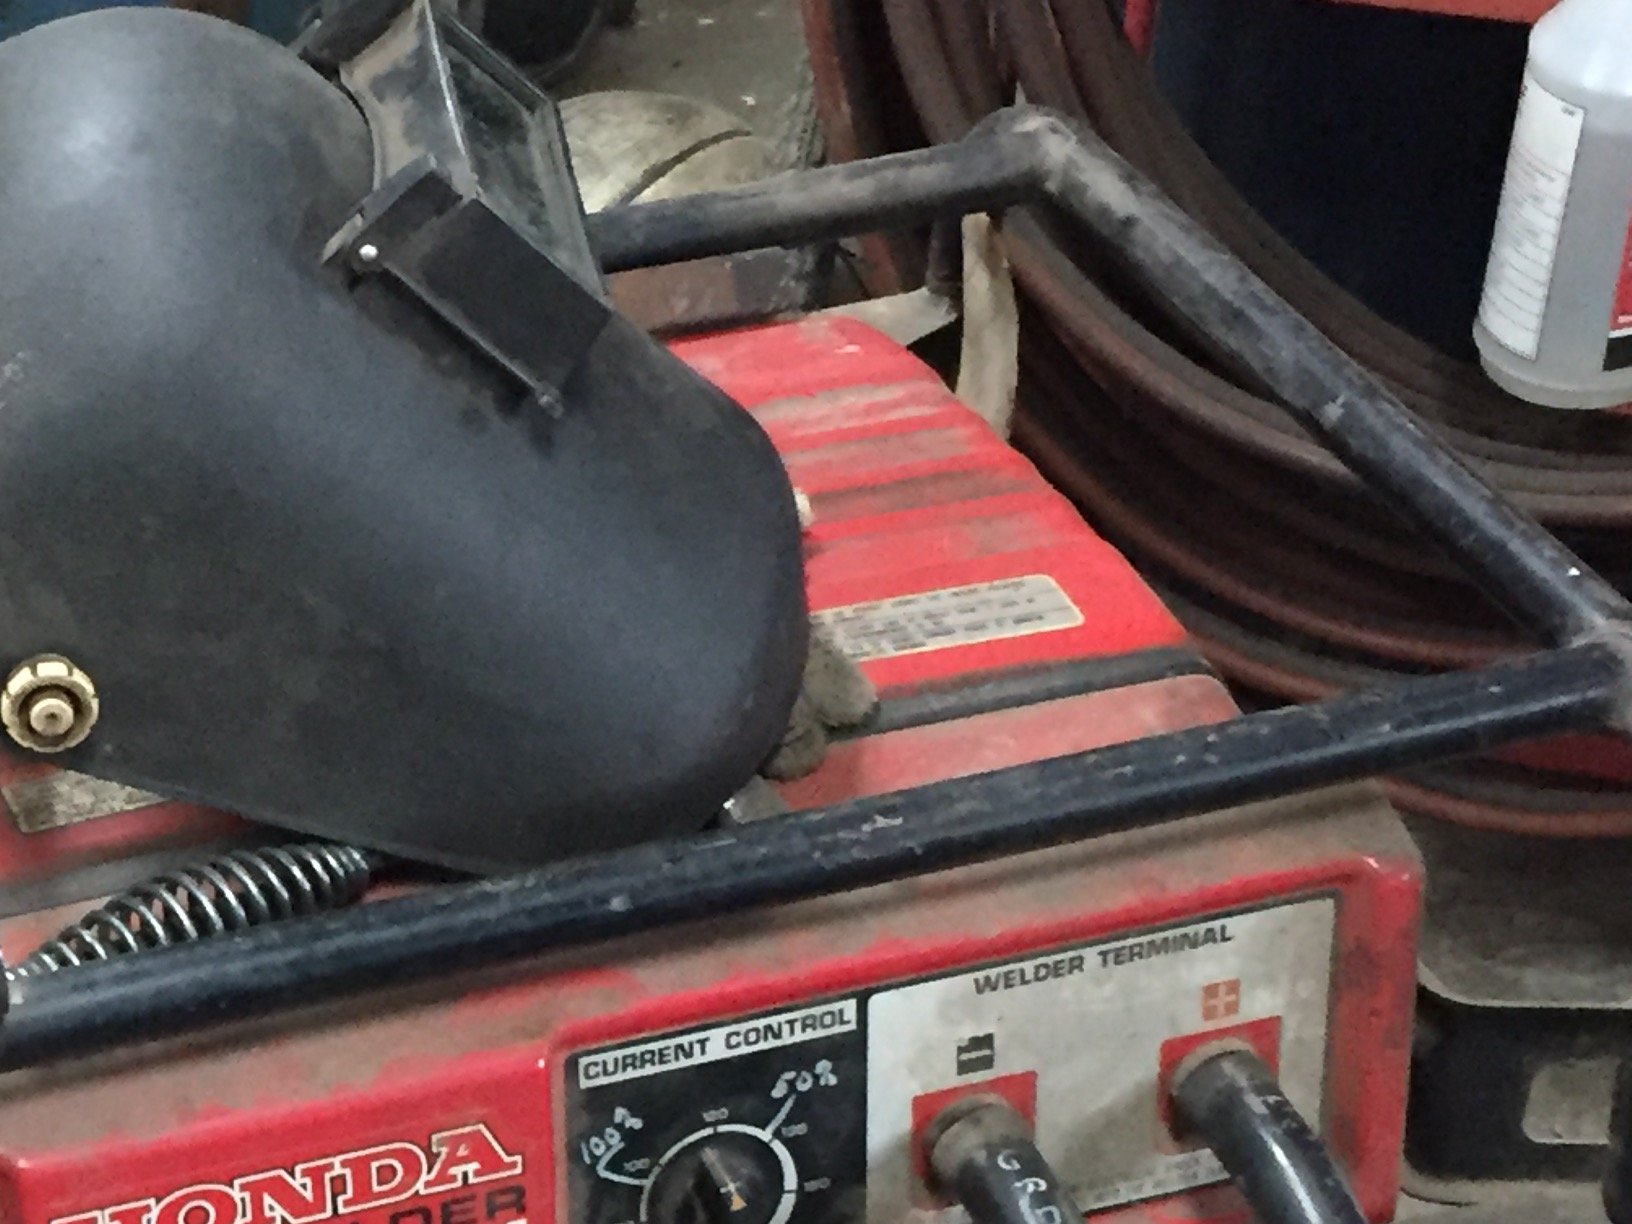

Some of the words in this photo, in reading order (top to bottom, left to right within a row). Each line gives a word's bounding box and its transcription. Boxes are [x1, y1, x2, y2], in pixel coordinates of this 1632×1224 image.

[973, 955, 1085, 995] WELDER
[1098, 924, 1235, 968] TERMINAL
[583, 1037, 710, 1080] CURRENT
[725, 1007, 852, 1050] CONTROL
